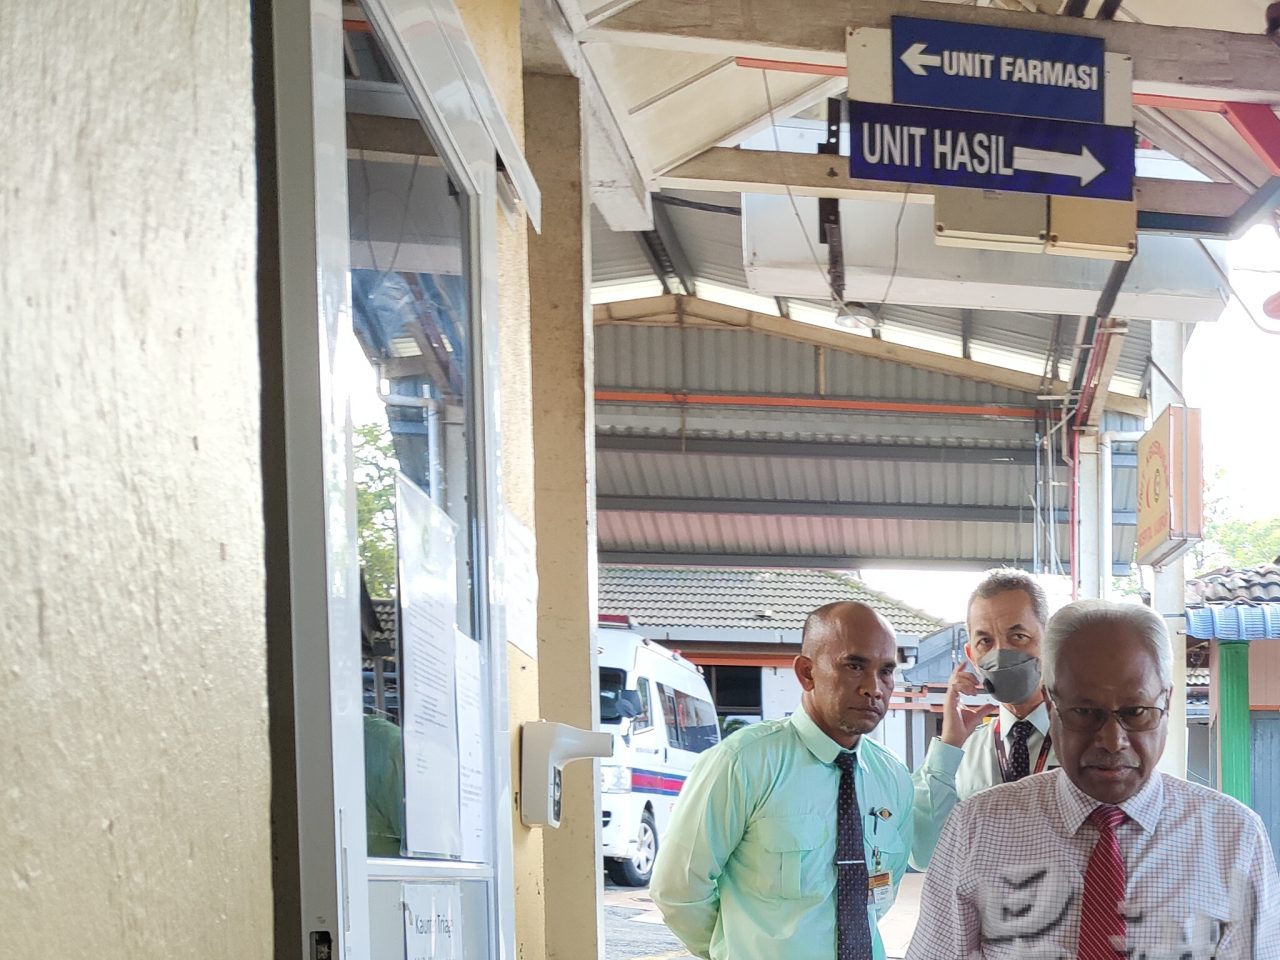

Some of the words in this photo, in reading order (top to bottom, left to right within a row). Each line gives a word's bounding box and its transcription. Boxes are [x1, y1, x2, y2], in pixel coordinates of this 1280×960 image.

[943, 50, 994, 79] UNIT
[1000, 56, 1098, 90] FARMASI
[862, 122, 927, 168] UNIT
[934, 129, 1015, 176] HASIL
